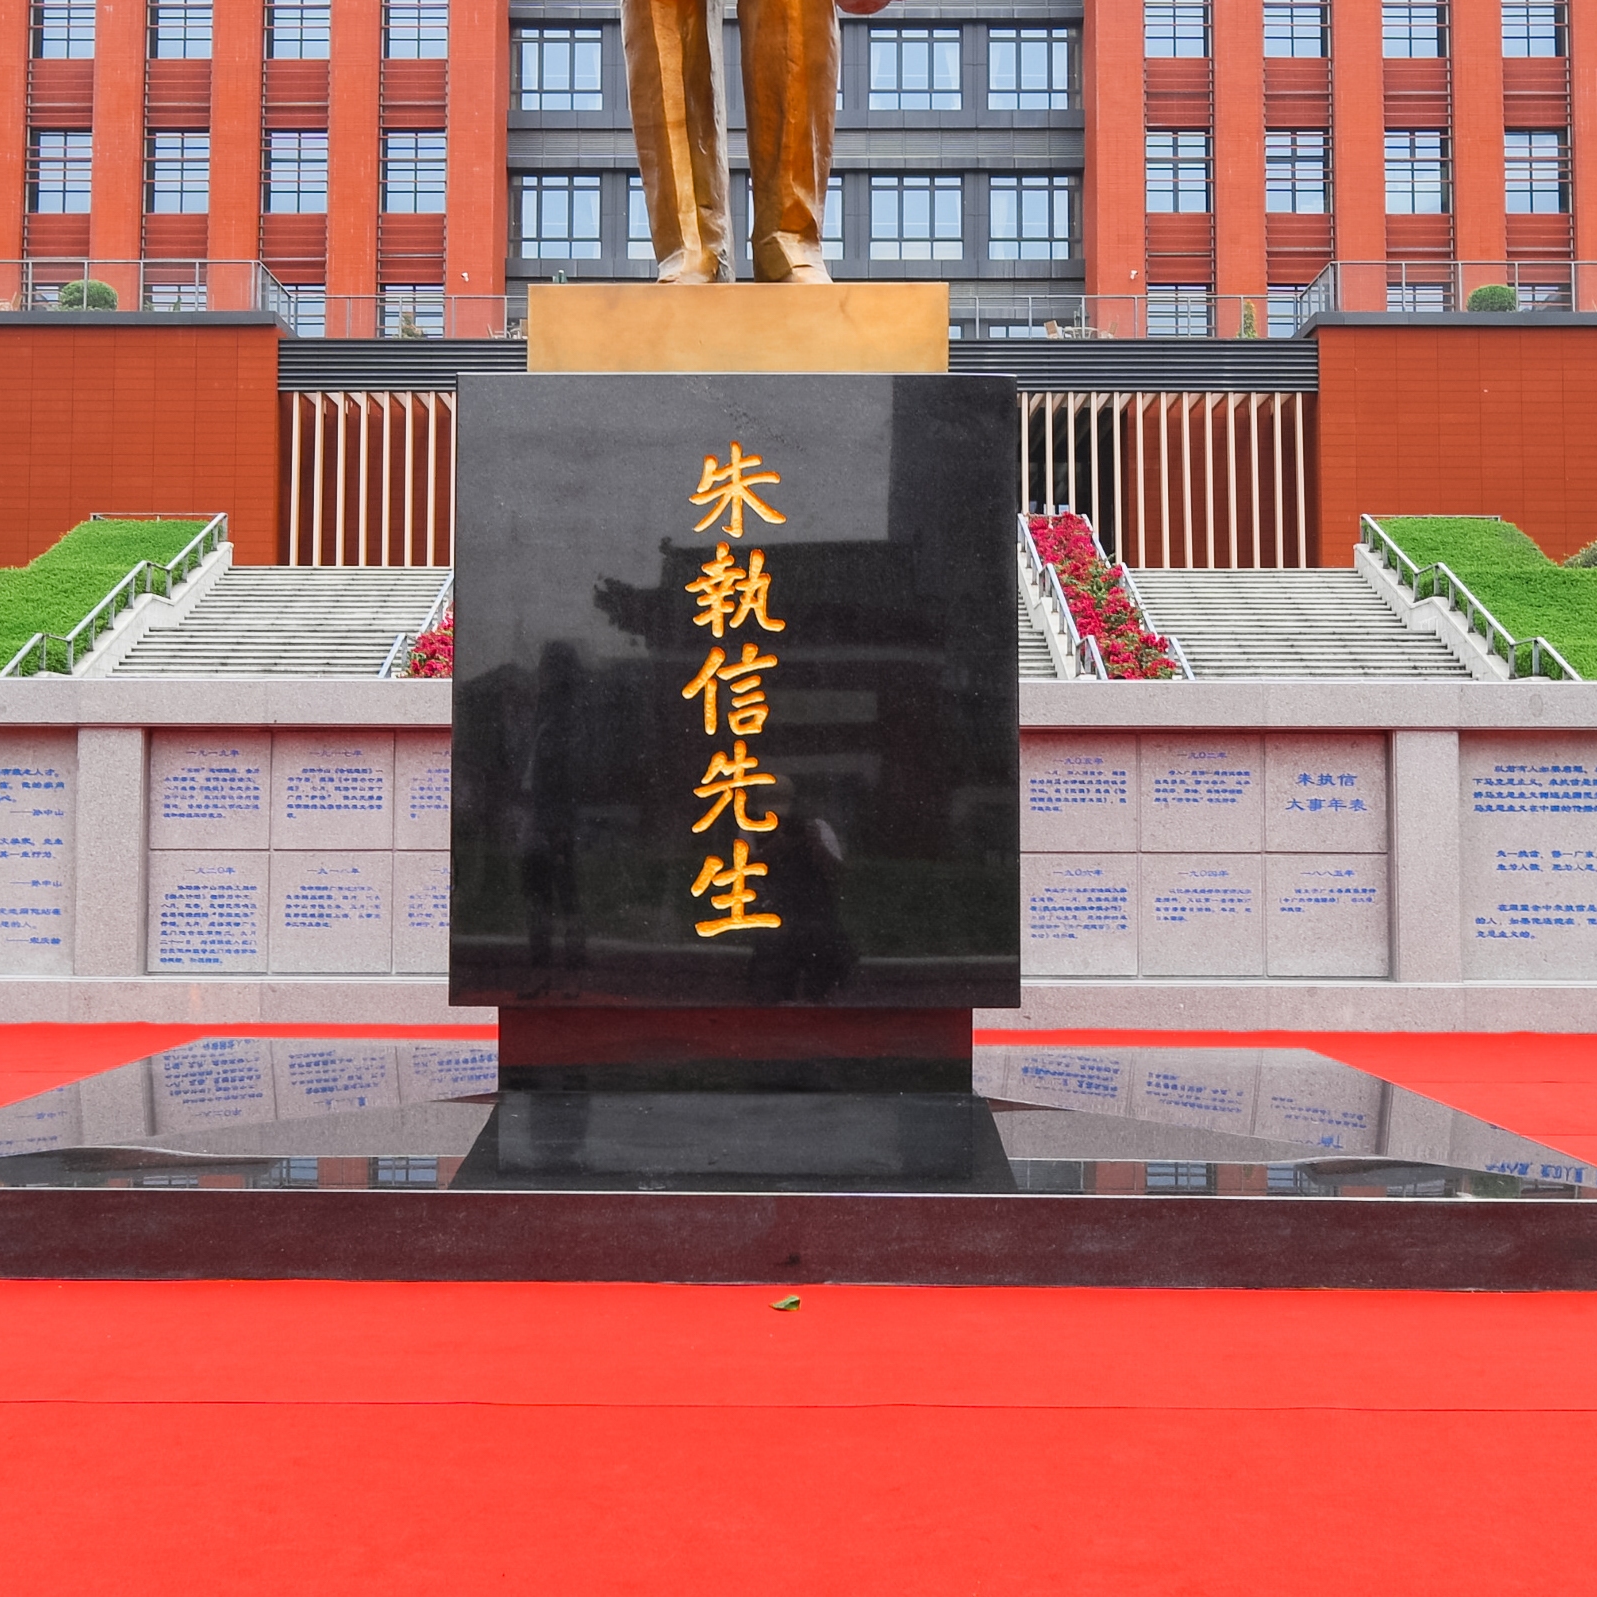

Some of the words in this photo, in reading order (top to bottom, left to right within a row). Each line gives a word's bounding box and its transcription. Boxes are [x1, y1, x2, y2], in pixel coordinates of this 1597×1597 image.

[681, 440, 787, 937] 朱執信先生
[1295, 772, 1358, 787] 朱执信
[1285, 798, 1368, 812] 大事年表
